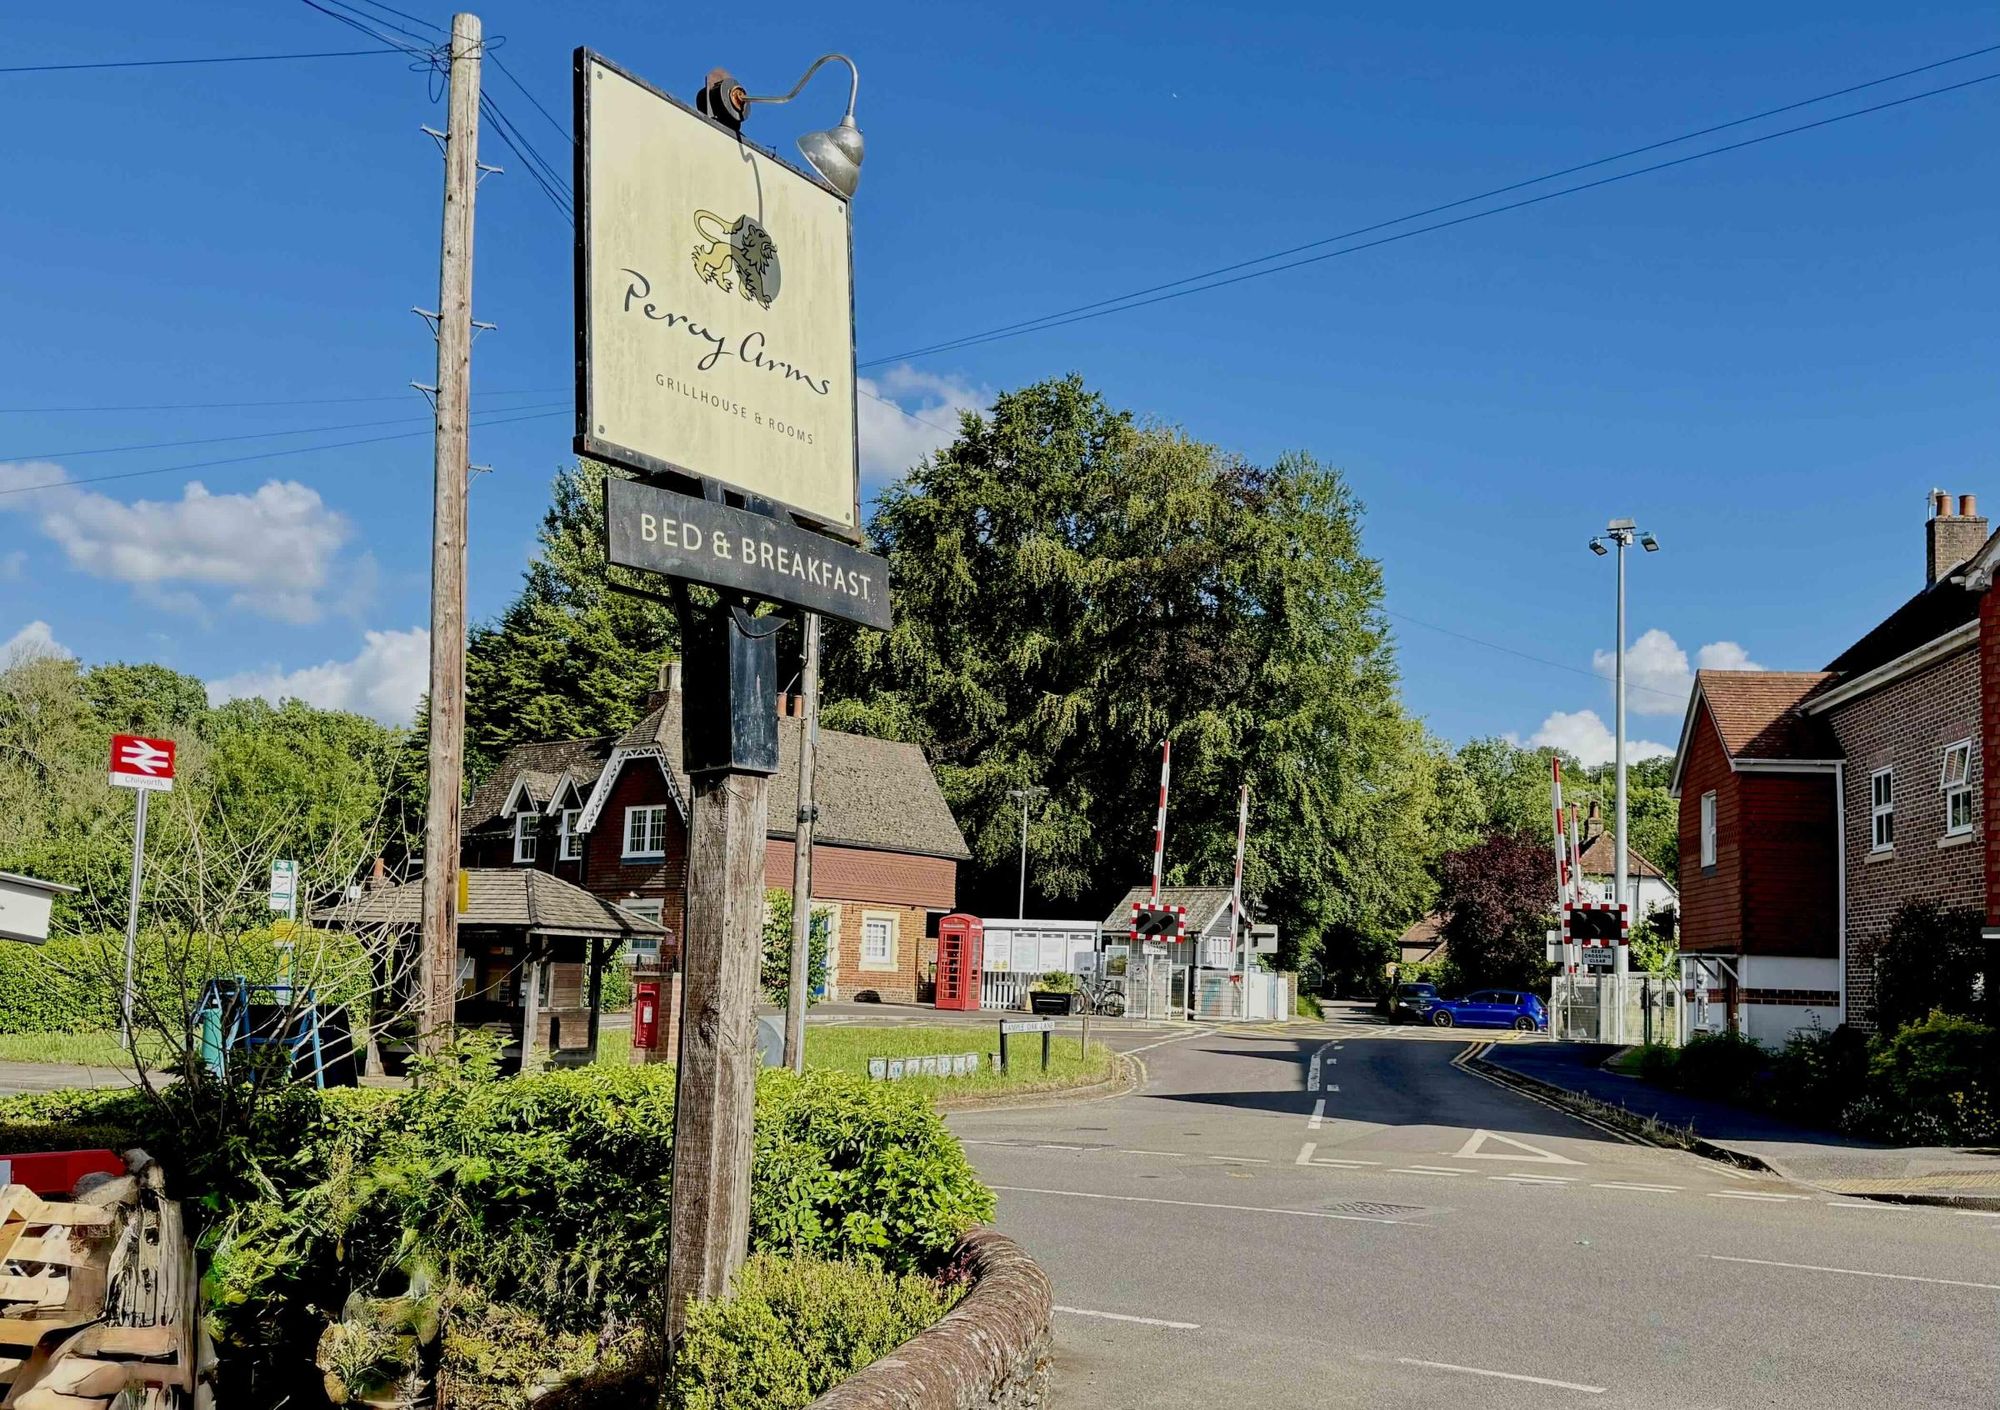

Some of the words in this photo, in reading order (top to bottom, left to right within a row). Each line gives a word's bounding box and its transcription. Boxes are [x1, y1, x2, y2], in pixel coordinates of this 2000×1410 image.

[620, 268, 734, 371] Percy
[655, 373, 747, 419] GRILLHOUSE
[754, 412, 762, 425] &
[768, 417, 813, 445] ROOMS
[641, 513, 703, 551] BED
[712, 531, 732, 560] &
[742, 537, 871, 601] BREAKFAST
